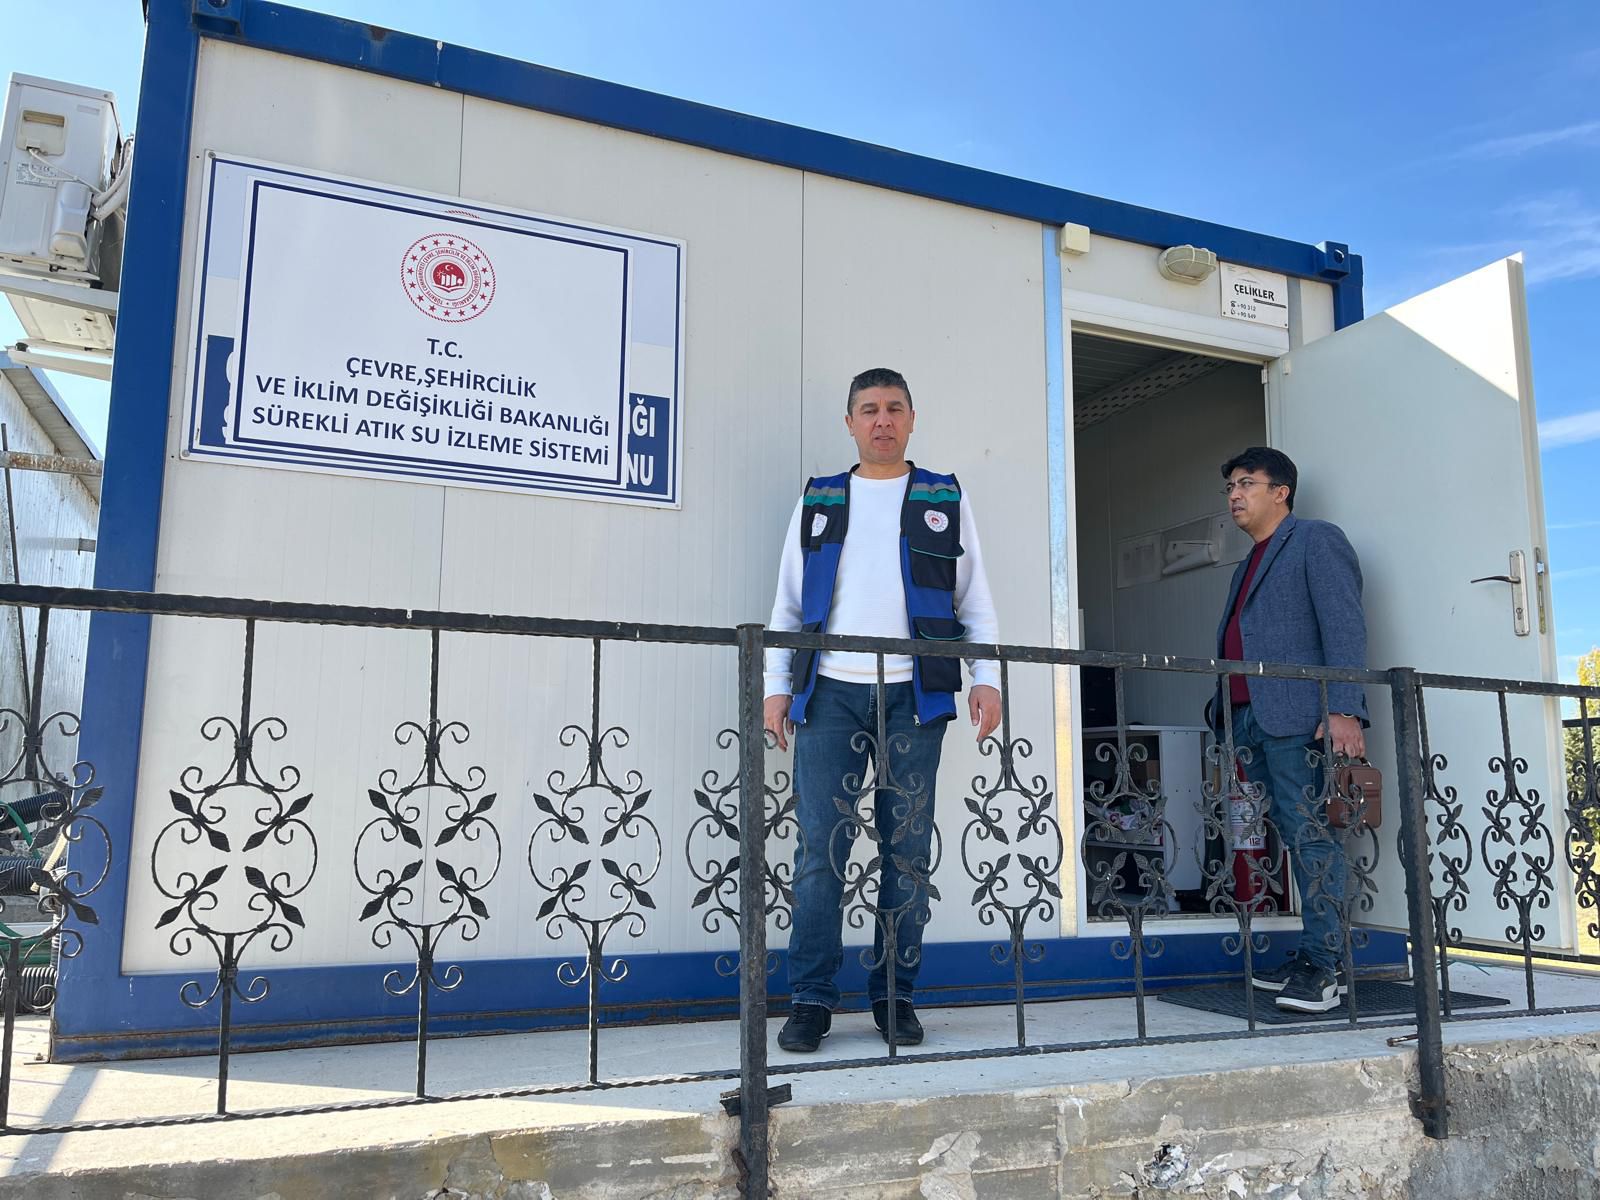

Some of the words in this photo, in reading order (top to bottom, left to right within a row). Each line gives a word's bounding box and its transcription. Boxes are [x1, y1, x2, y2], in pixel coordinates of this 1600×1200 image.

[1234, 284, 1275, 301] ÇELİKLER
[427, 338, 463, 359] T.C.
[346, 358, 537, 399] ÇEVRE,ŞEHİRCİLİK
[256, 375, 286, 396] VE
[294, 376, 359, 405] İKLİM
[366, 389, 493, 422] DEĞİŞİKLİĞİ
[500, 407, 609, 437] BAKANLIĞI
[629, 397, 656, 437] ĞI
[252, 404, 349, 434] SÜREKLİ
[355, 419, 406, 441] ATIK
[411, 425, 440, 445] SU
[447, 426, 524, 456] İZLEME
[529, 438, 609, 466] SİSTEMİ
